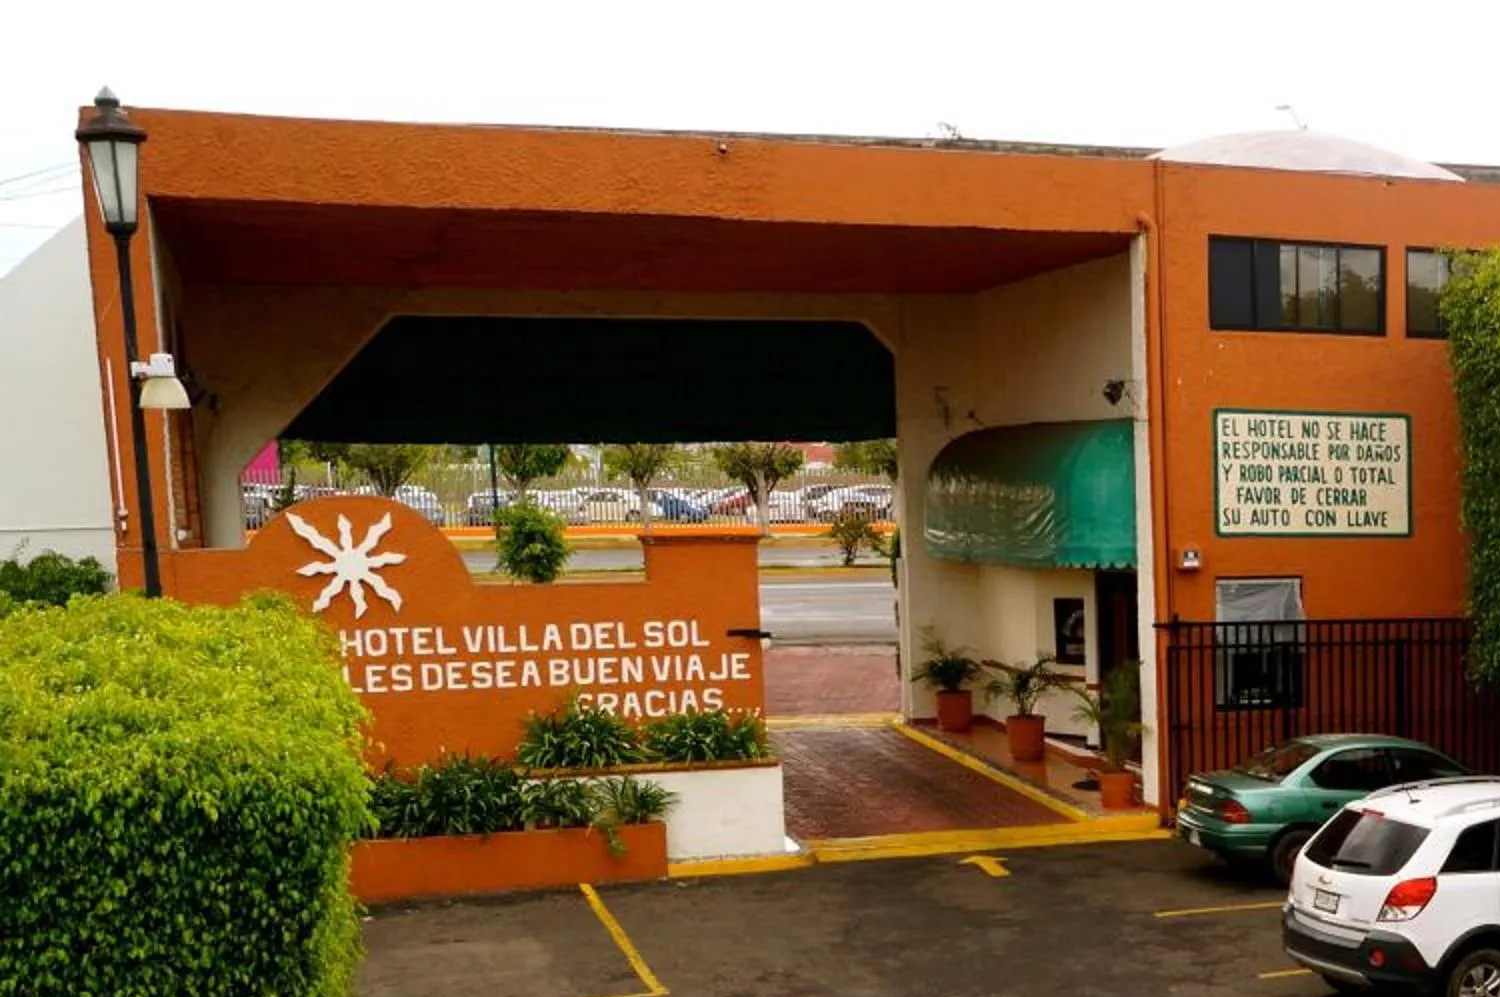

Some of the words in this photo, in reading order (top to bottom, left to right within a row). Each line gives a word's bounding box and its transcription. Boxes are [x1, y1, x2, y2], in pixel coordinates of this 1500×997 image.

[1221, 418, 1240, 437] EL
[1247, 419, 1294, 439] HOTEL
[1301, 420, 1320, 440] NO
[1327, 421, 1341, 441] SE
[1350, 422, 1387, 442] HACE
[1221, 441, 1320, 461] RESPONSABLE
[1328, 443, 1351, 461] POR
[1356, 444, 1401, 463] DAÑOS
[1222, 463, 1233, 482] Y
[1239, 464, 1273, 483] ROBO
[1278, 465, 1327, 484] PARCIAL
[1334, 466, 1343, 484] O
[1350, 467, 1397, 485] TOTAL
[1236, 487, 1282, 505] FAVOR
[1291, 488, 1307, 505] DE
[1315, 488, 1368, 506] CERRAR
[1222, 507, 1241, 527] SU
[1249, 509, 1291, 527] AUTO
[1305, 509, 1337, 527] CON
[1347, 511, 1388, 528] LLAVE
[338, 626, 457, 658] HOTEL
[462, 623, 564, 654] VILLA
[569, 621, 637, 651] DEL
[642, 619, 710, 648] SOL
[341, 660, 414, 694] LES
[420, 659, 542, 691] DESEA
[548, 655, 644, 686] BUEN
[651, 653, 751, 682] VIAJE
